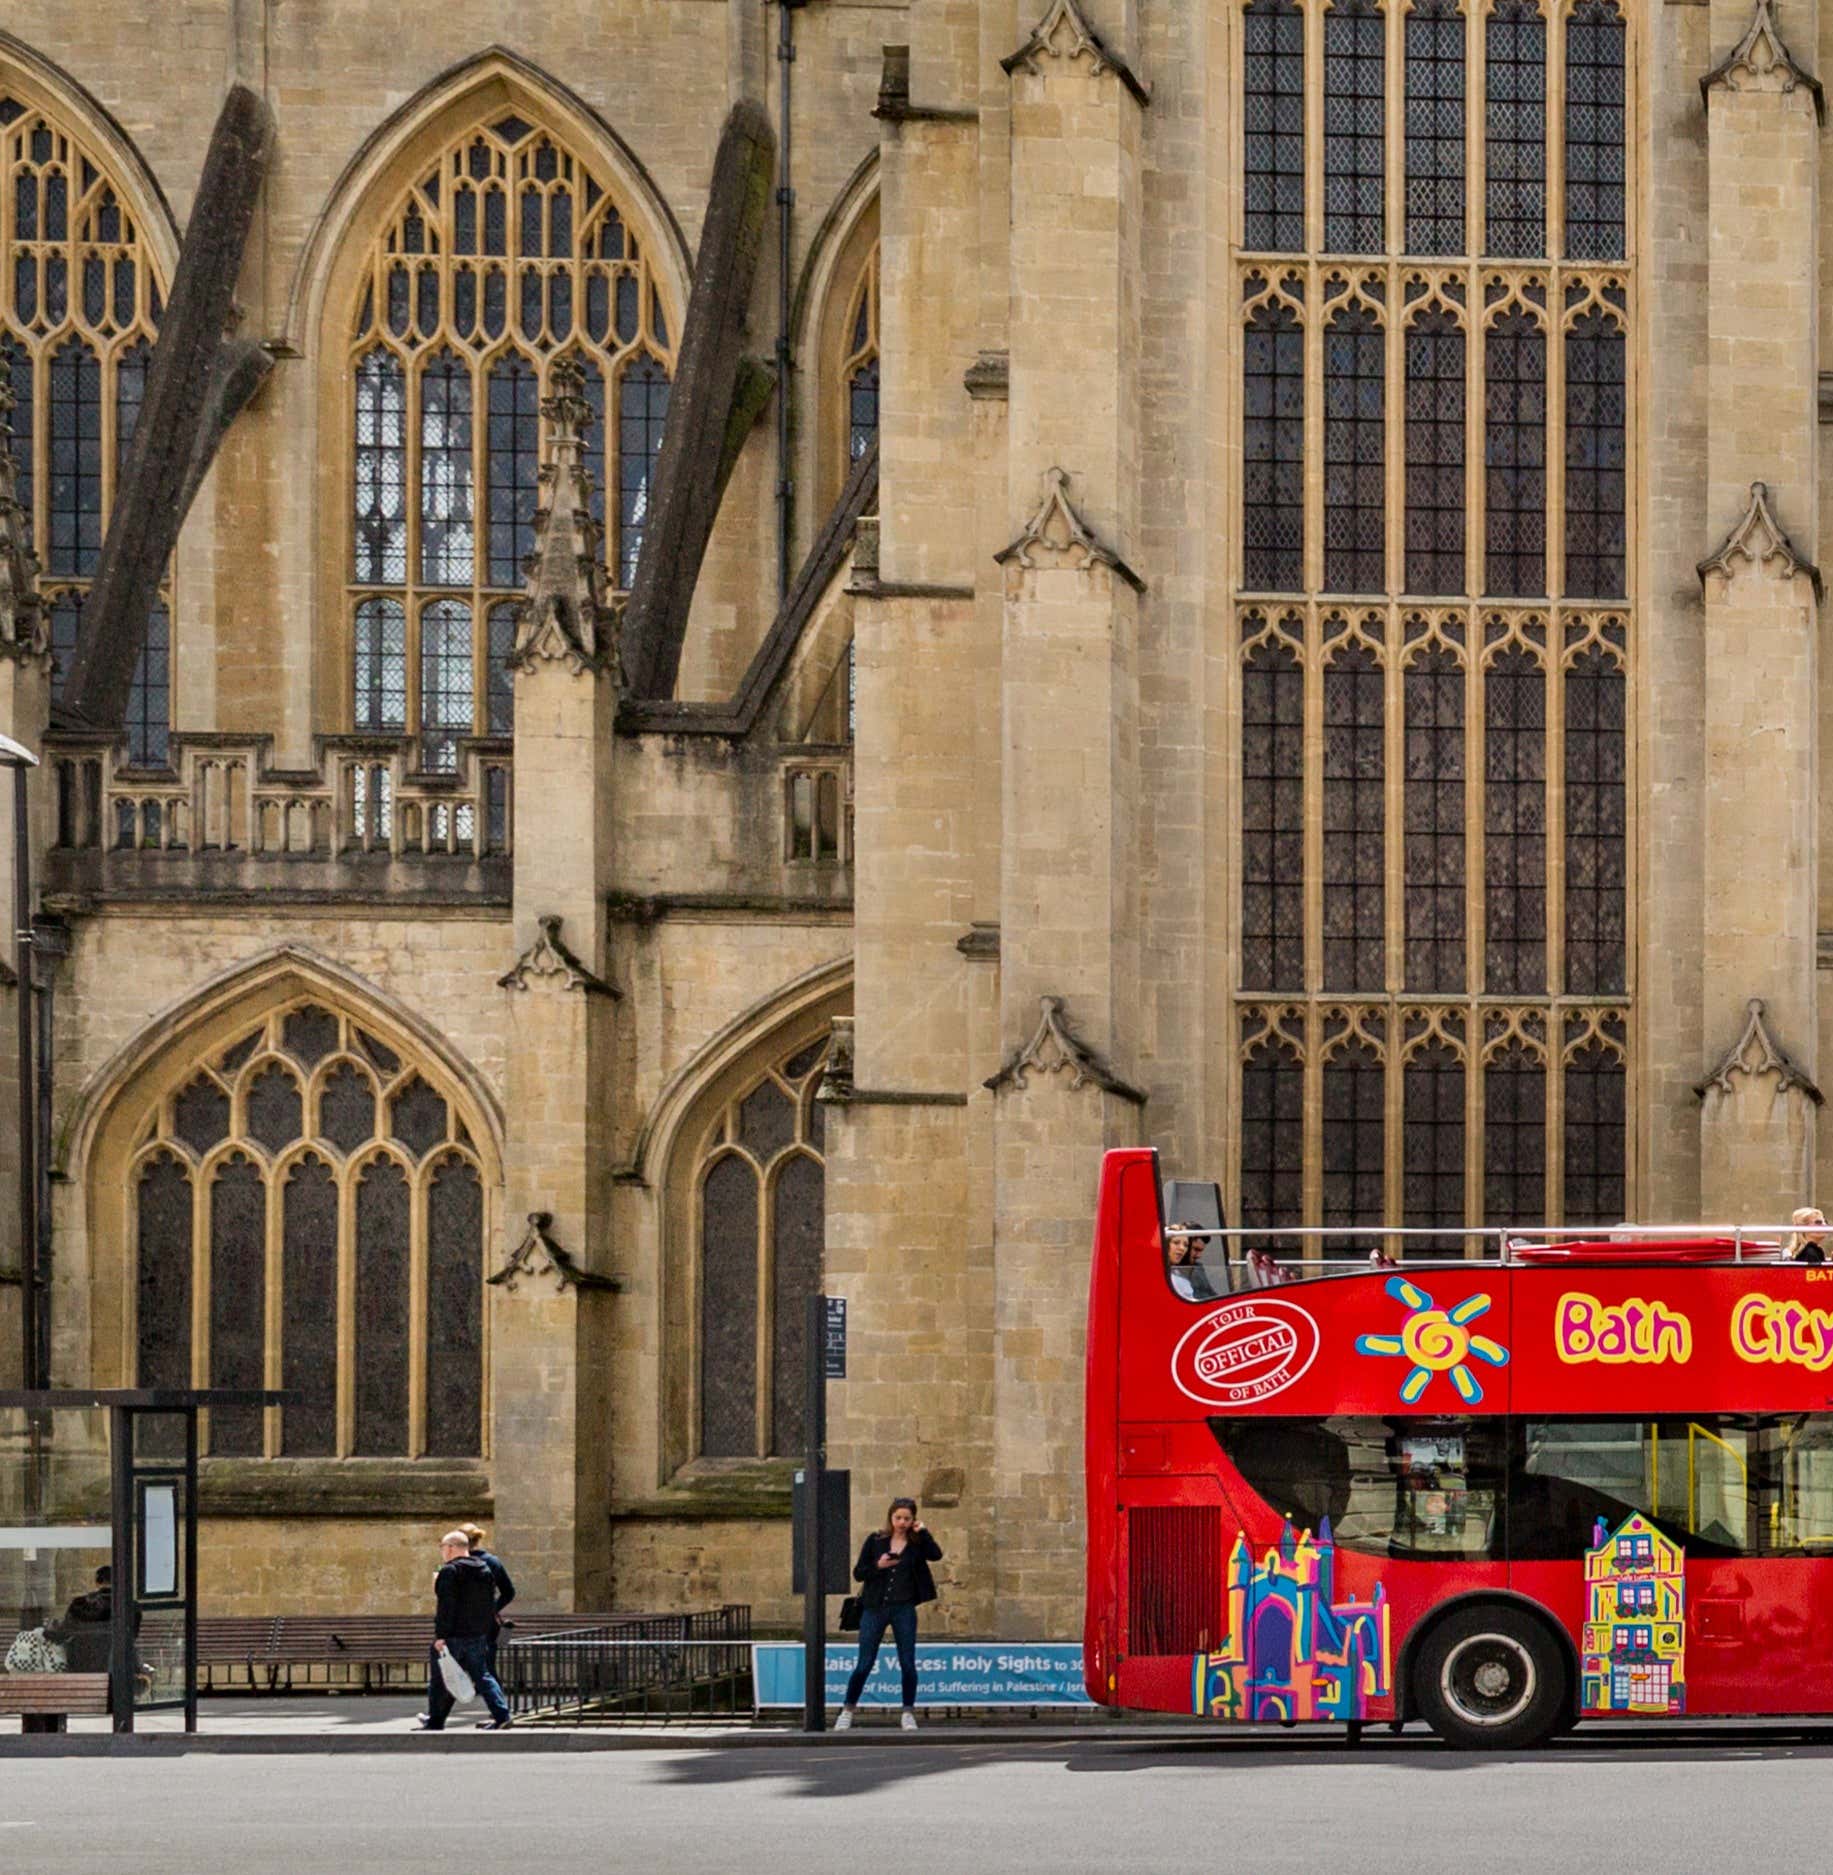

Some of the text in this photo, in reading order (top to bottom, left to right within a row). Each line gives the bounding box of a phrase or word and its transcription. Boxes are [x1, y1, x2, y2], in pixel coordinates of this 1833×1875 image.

[1207, 1306, 1256, 1331] TOUR
[1556, 1293, 1691, 1364] Bath
[1199, 1332, 1292, 1374] OFFICIAL
[1229, 1368, 1291, 1400] OF BATH
[952, 1655, 992, 1674] Holy
[998, 1655, 1052, 1673] Sights
[1054, 1661, 1068, 1671] to
[878, 1682, 903, 1695] Hop
[938, 1681, 990, 1694] Suffering
[992, 1681, 1003, 1692] in
[1006, 1681, 1057, 1692] Palestine
